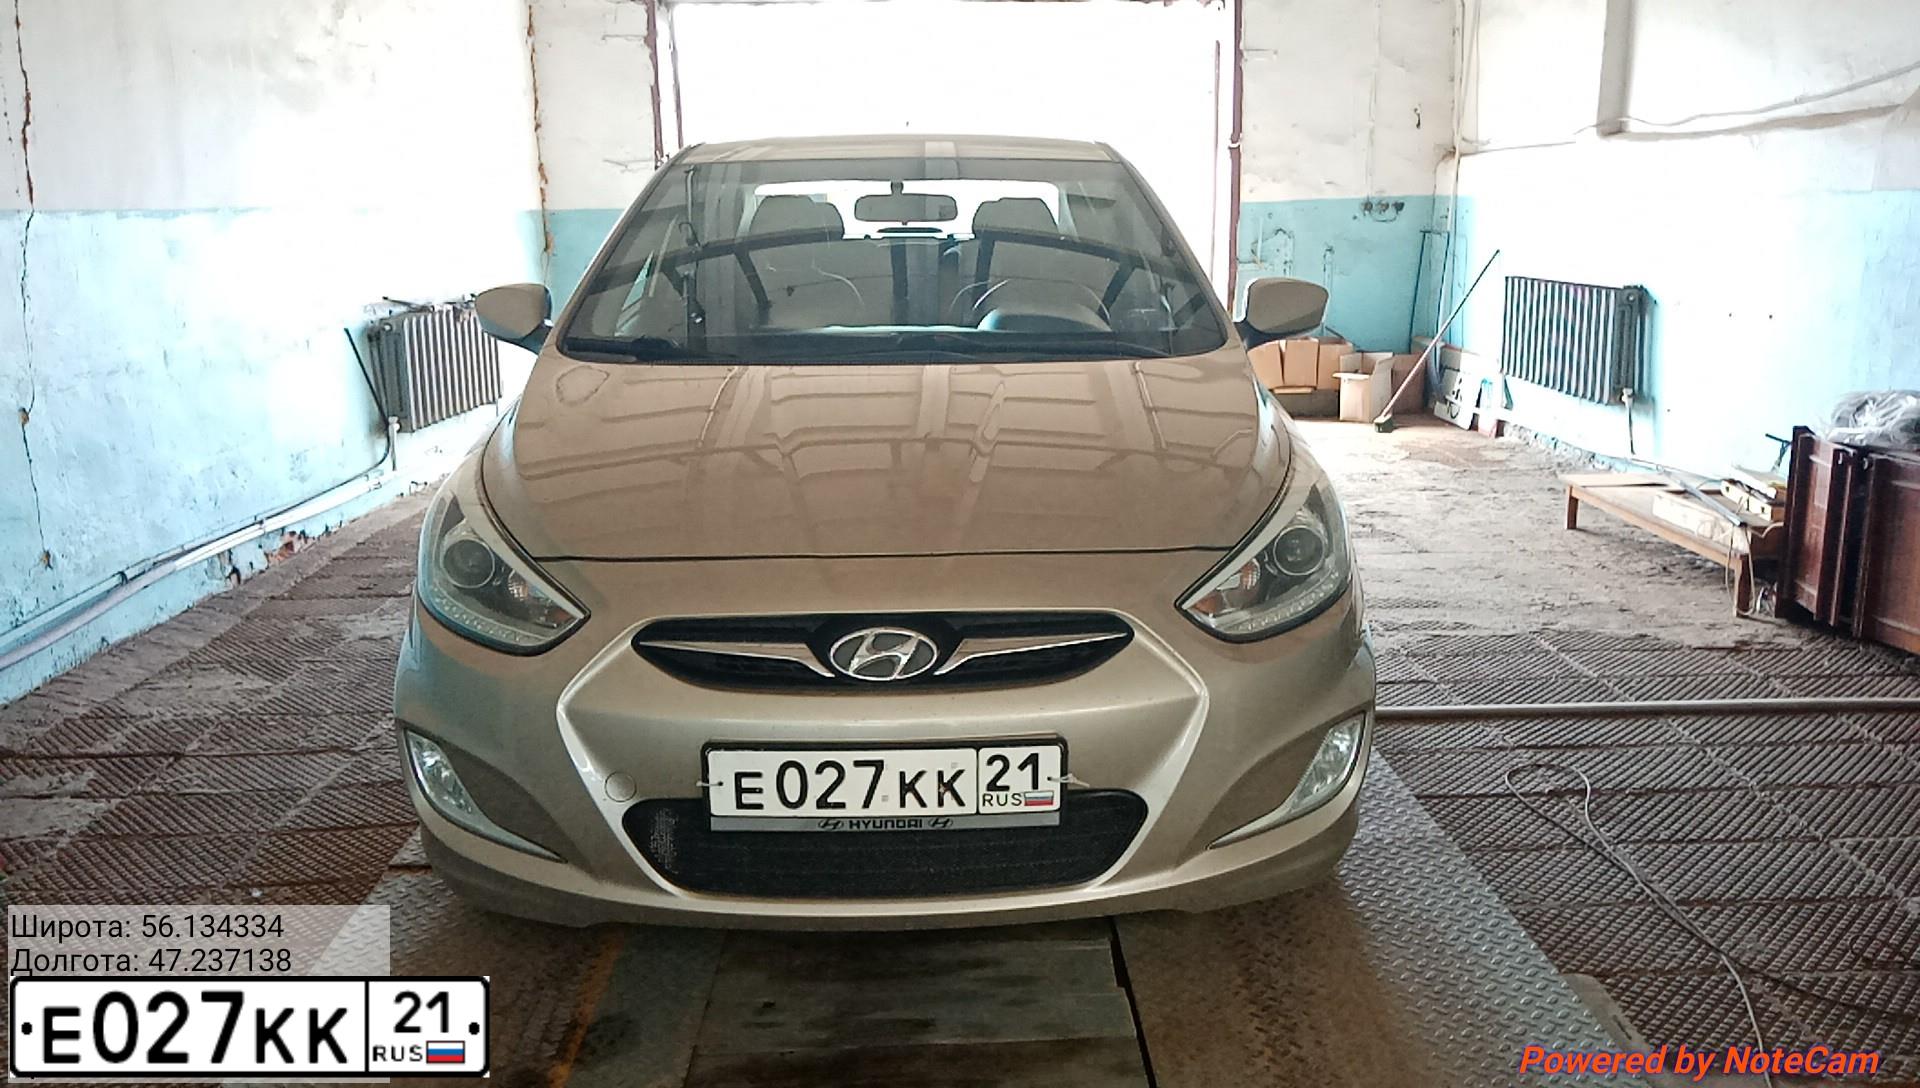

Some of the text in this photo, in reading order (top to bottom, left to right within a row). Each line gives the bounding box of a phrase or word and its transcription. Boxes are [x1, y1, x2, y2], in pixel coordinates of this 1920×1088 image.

[986, 753, 1040, 792] 21
[982, 792, 1022, 807] RUS
[848, 819, 923, 830] HYUNDAI
